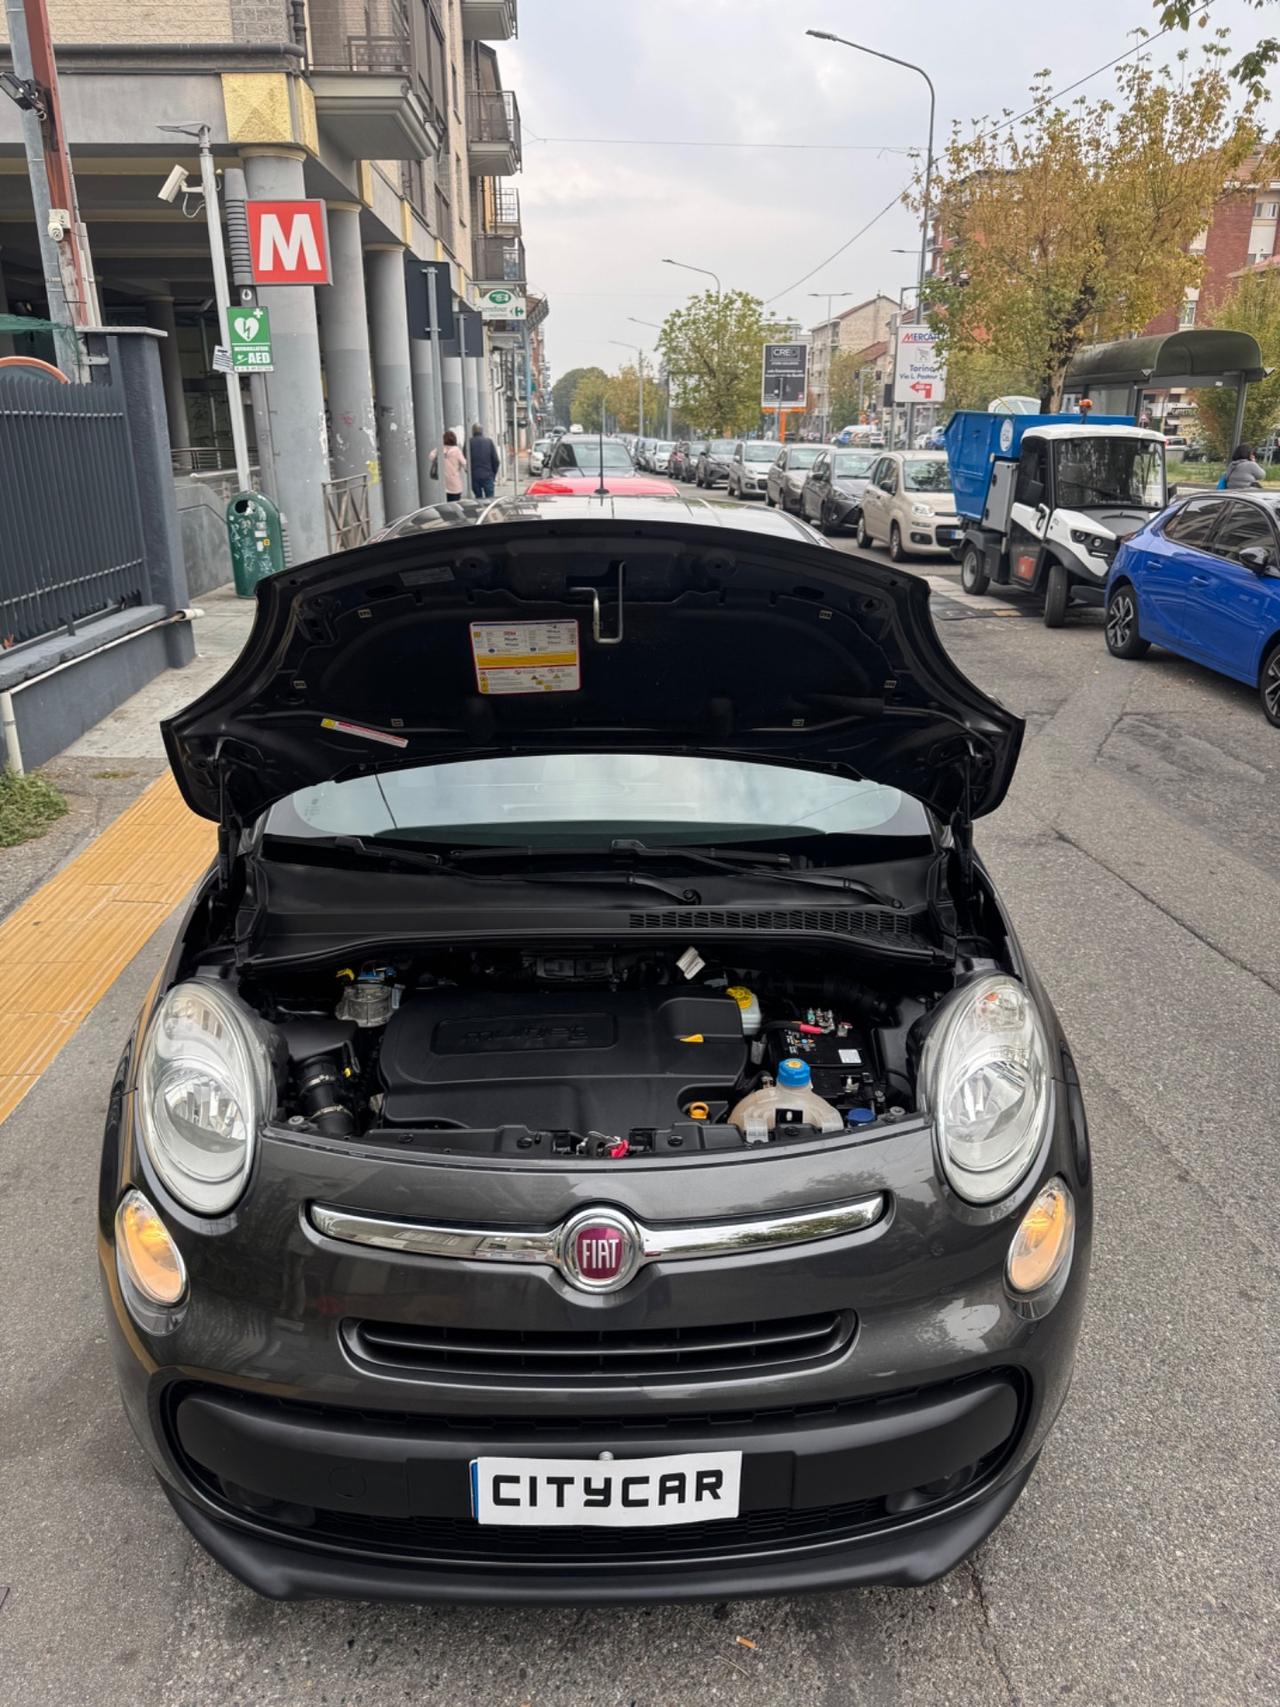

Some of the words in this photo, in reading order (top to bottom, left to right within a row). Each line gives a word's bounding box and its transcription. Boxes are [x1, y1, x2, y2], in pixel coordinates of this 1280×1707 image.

[259, 213, 322, 271] M
[248, 352, 271, 364] AED
[582, 1239, 619, 1268] FIAT
[492, 1469, 722, 1508] CITYCAR
